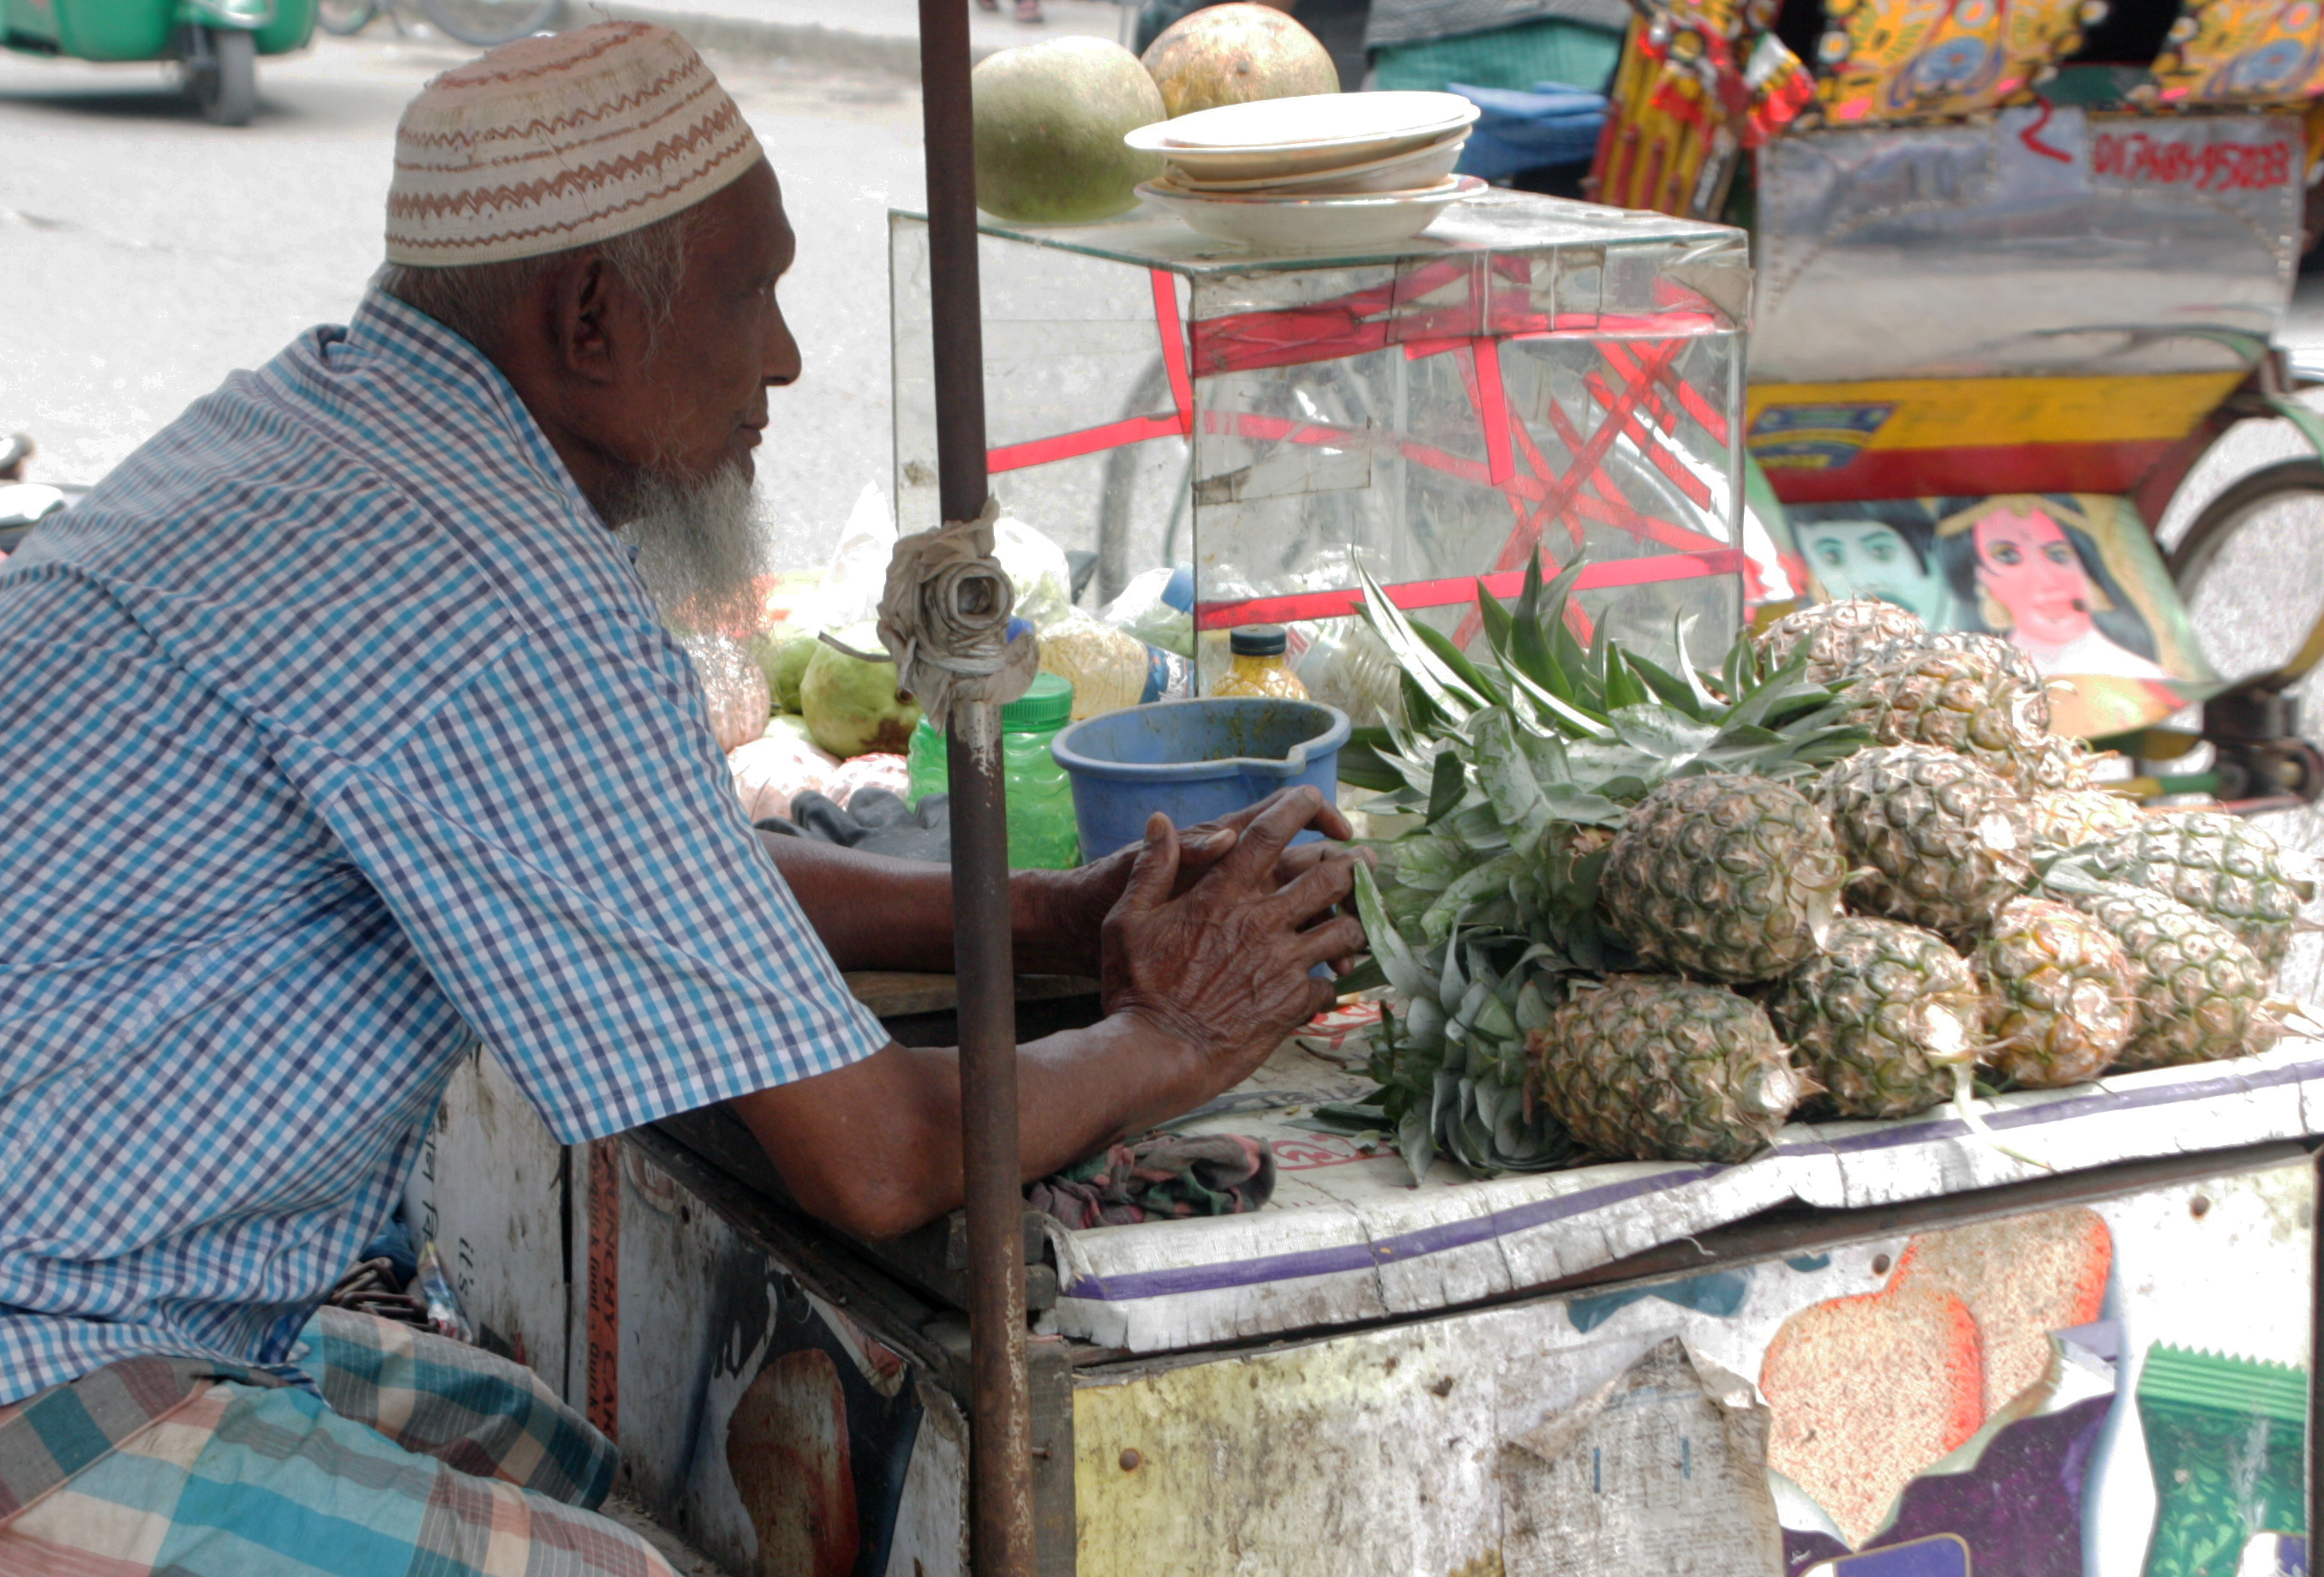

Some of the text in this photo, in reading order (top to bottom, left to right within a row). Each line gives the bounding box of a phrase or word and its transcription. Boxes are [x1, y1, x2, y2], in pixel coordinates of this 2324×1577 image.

[458, 1237, 475, 1297] it's
[590, 1256, 601, 1311] food
[589, 1342, 601, 1412] Quick
[602, 1351, 616, 1441] CAK
